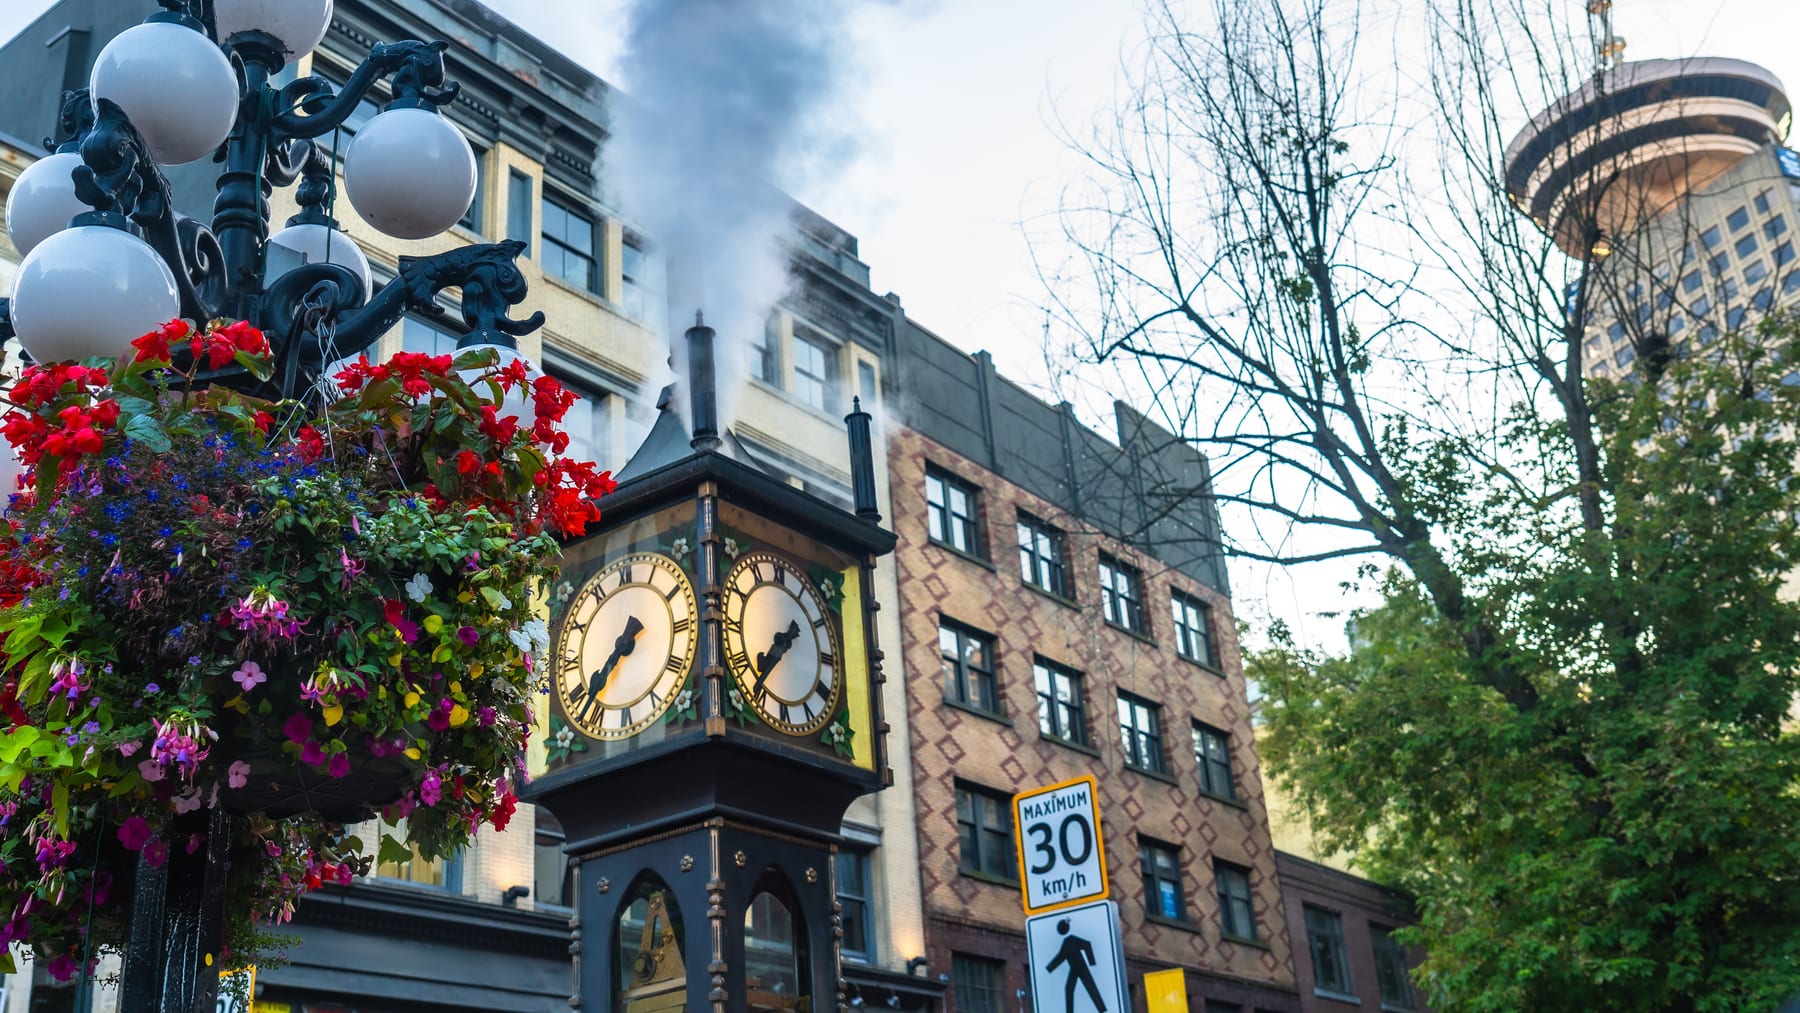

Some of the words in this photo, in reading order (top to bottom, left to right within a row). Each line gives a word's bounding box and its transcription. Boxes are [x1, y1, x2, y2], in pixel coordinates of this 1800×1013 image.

[619, 565, 632, 587] XII
[648, 565, 657, 585] I
[591, 584, 606, 605] XI
[571, 620, 587, 634] X
[674, 618, 689, 634] III
[728, 617, 741, 634] IX
[821, 652, 833, 665] III
[649, 690, 662, 708] V
[621, 707, 633, 728] VI
[803, 703, 814, 722] V
[1023, 791, 1087, 820] MAXIMUM
[1027, 813, 1092, 875] 30
[1042, 871, 1086, 896] km/h
